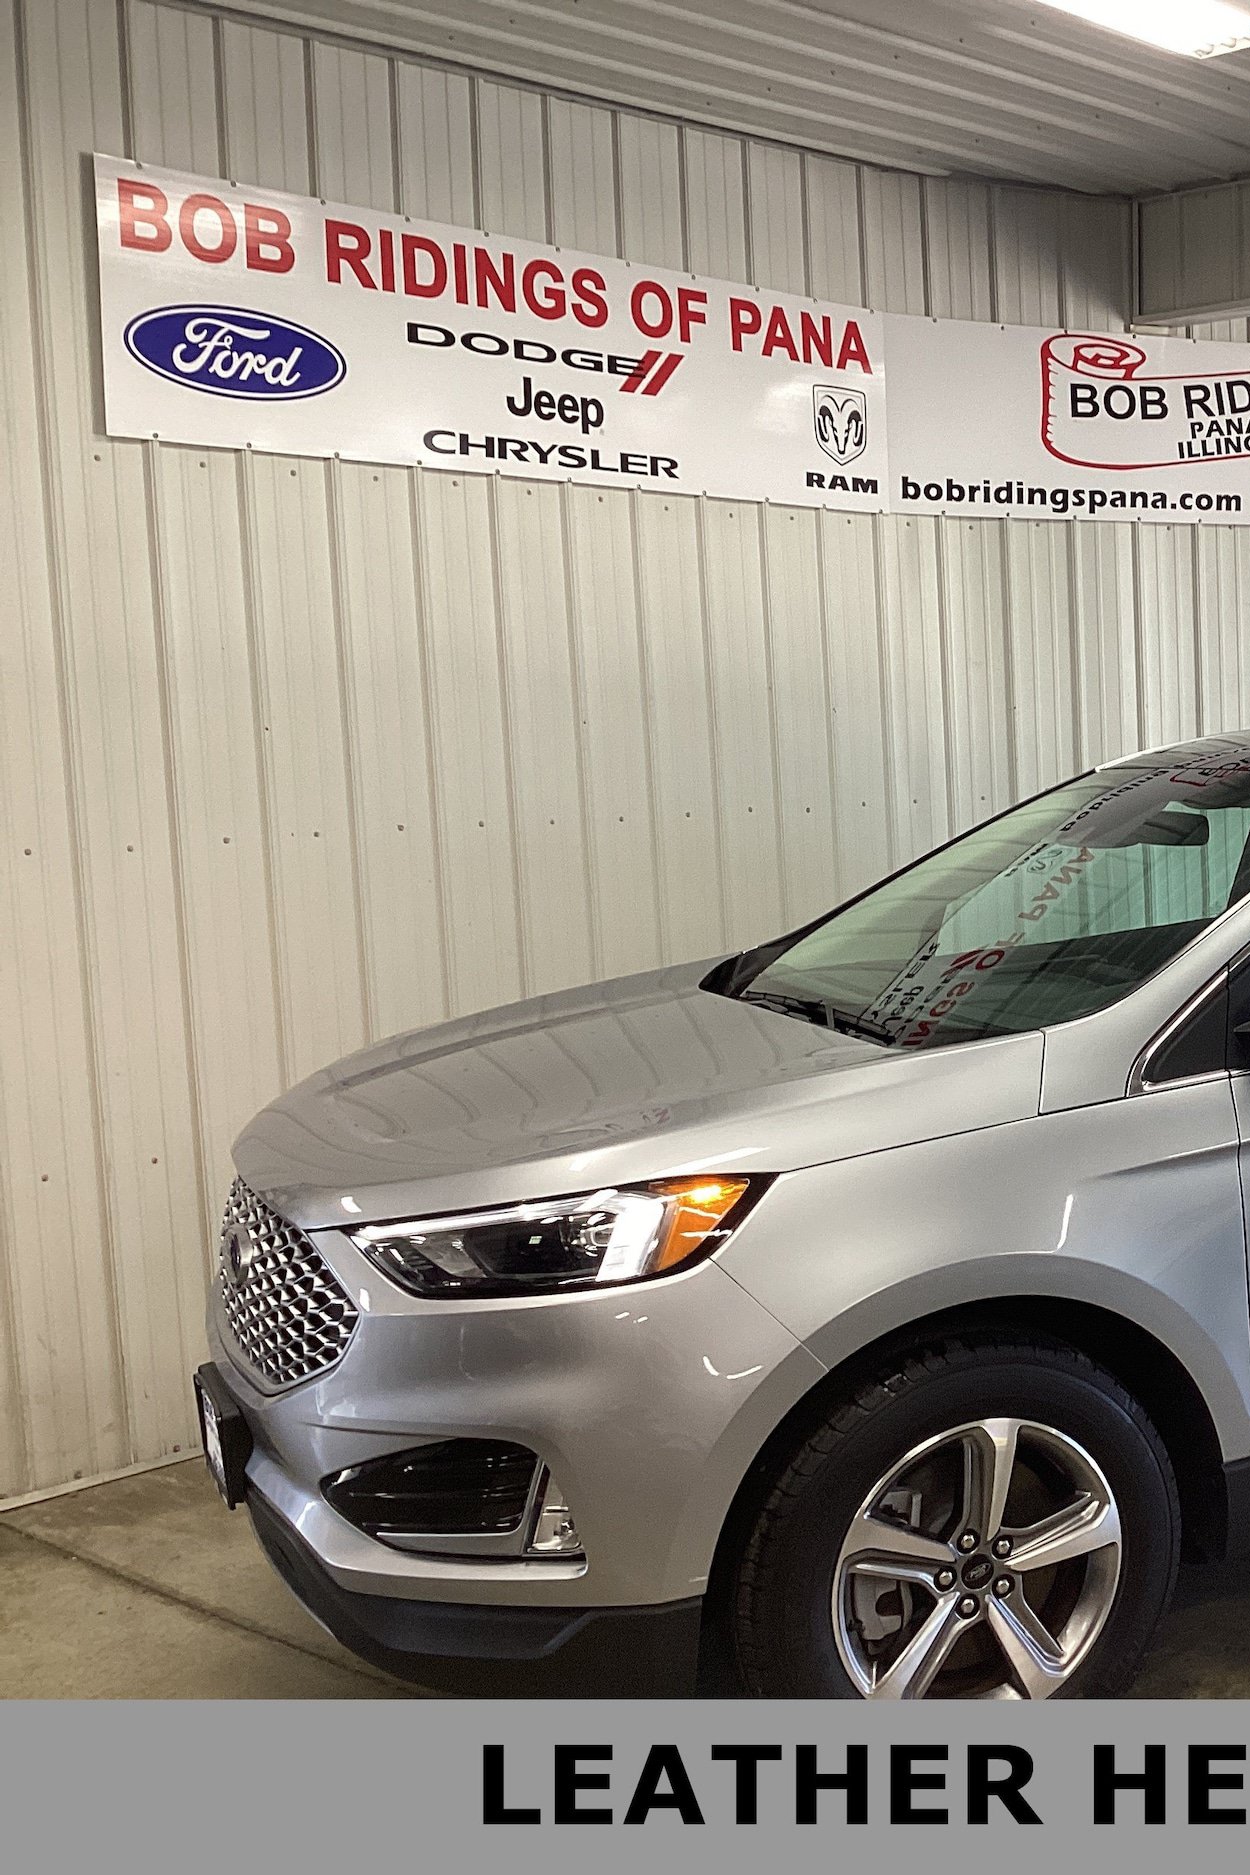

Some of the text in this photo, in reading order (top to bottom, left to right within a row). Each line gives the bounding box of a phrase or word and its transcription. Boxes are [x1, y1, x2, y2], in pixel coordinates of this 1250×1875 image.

[117, 177, 872, 374] BOB RIDINGS OF PANA
[171, 317, 303, 387] Ford
[407, 322, 646, 378] DODGE
[507, 377, 604, 434] Jeep
[1070, 383, 1168, 420] BOB
[423, 430, 679, 479] CHRYSLER
[806, 472, 878, 495] RAM
[901, 476, 1242, 517] bobridingspana.com
